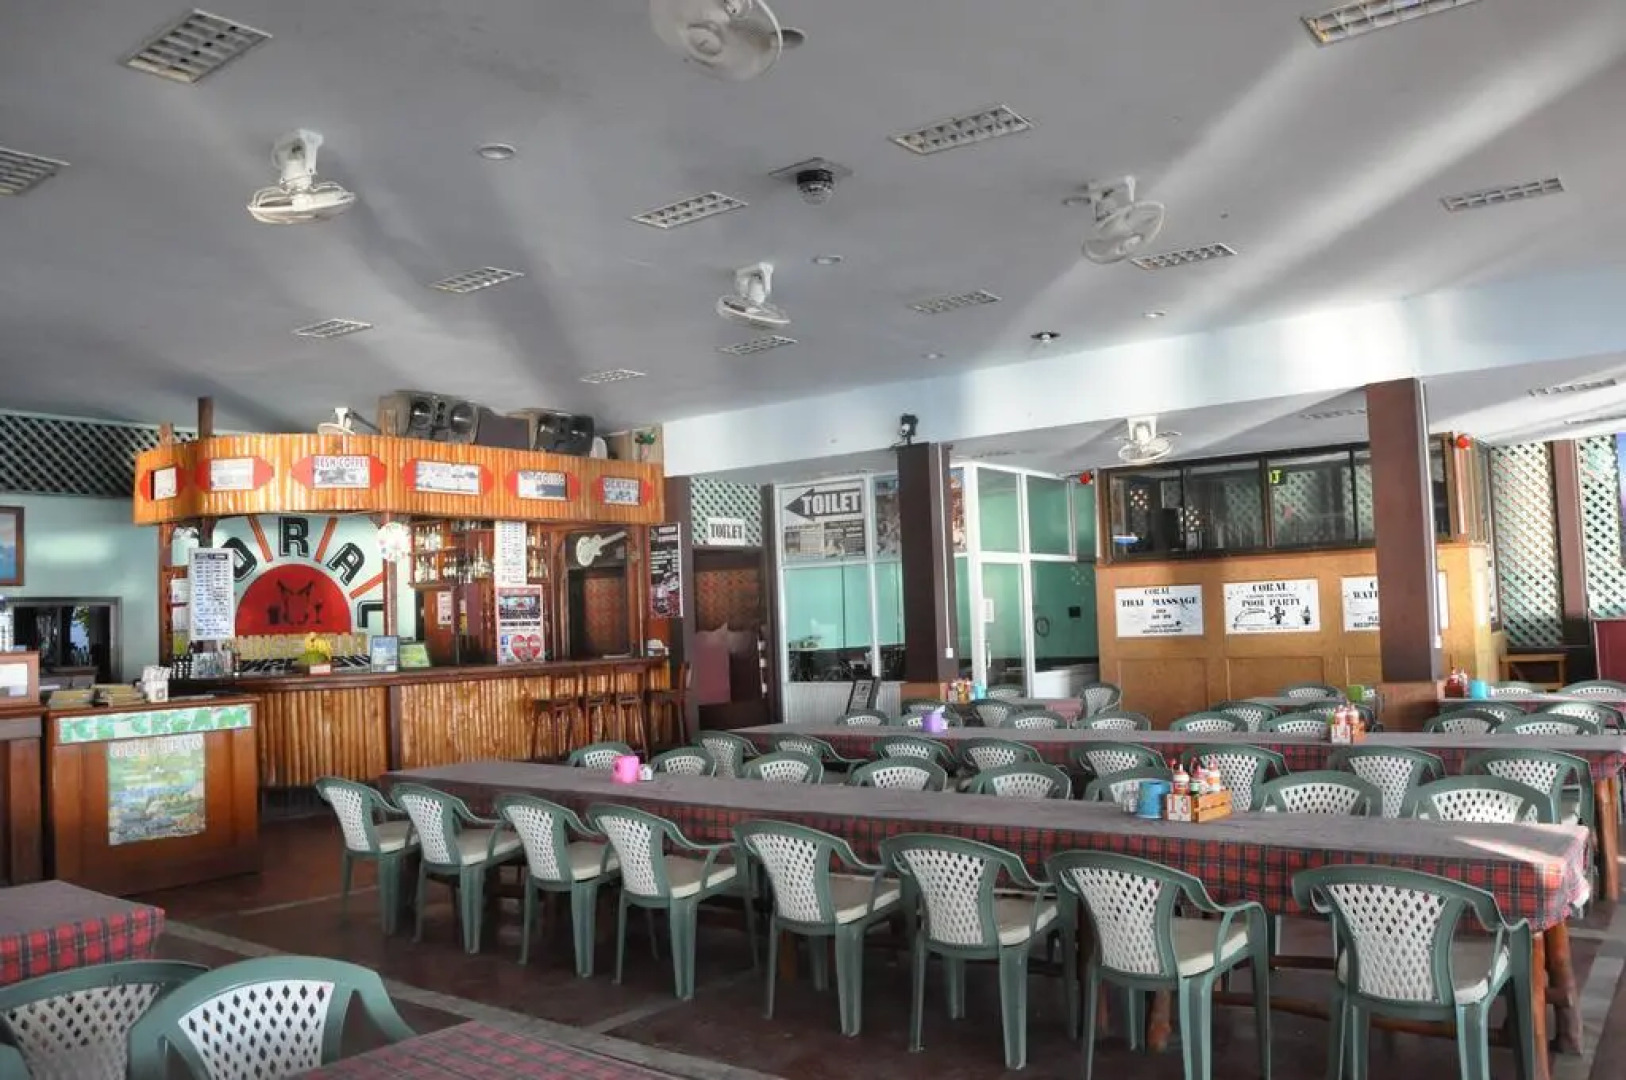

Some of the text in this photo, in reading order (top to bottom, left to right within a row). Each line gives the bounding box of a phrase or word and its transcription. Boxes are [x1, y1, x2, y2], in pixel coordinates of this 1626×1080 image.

[801, 491, 861, 515] TOILET
[711, 523, 743, 539] TOILET
[1144, 587, 1170, 595] CORAL
[1252, 582, 1287, 592] CORAL
[1121, 596, 1196, 607] THAI MASSAGE
[1241, 598, 1300, 607] POOL PARTY
[132, 706, 249, 734] CREAM
